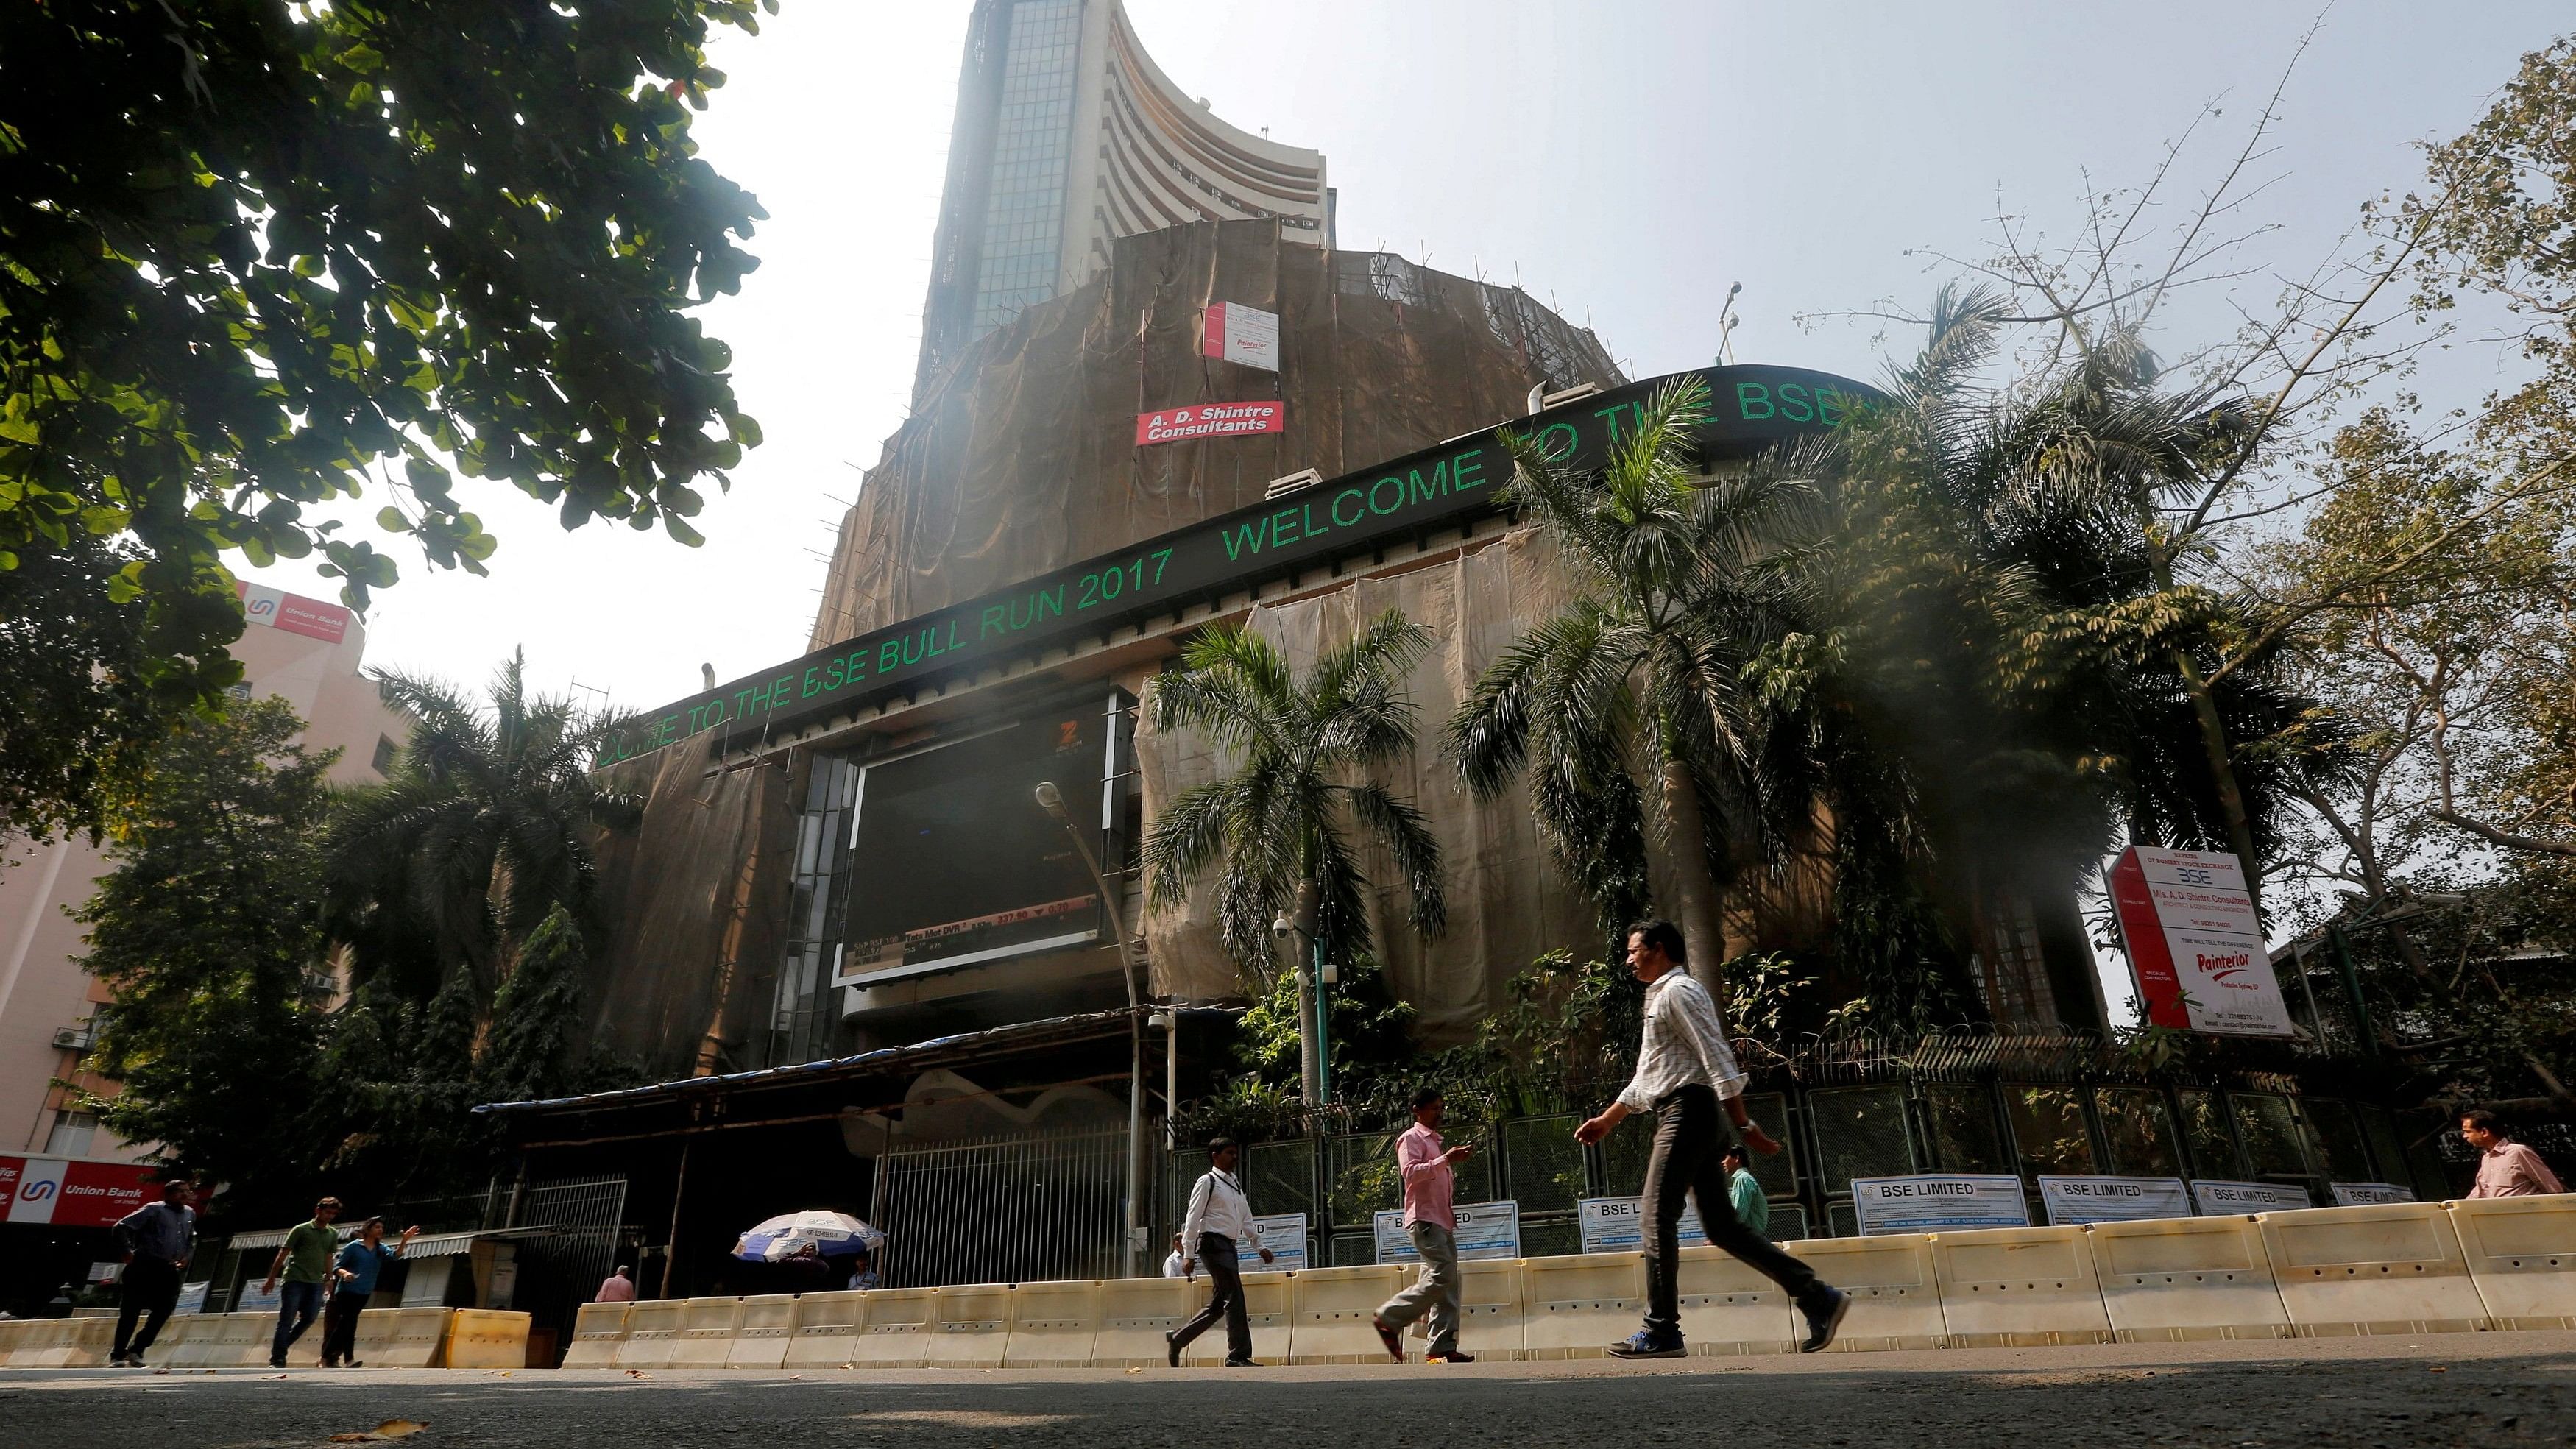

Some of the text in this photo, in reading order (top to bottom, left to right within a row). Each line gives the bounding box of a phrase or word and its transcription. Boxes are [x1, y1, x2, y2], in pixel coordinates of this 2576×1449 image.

[1236, 339, 1267, 349] Painterior
[1148, 406, 1273, 428] A. D. Shintre
[1148, 419, 1267, 440] Consultants
[688, 699, 725, 735] TO
[735, 675, 793, 720] THE
[877, 620, 967, 674] BULL
[980, 584, 1066, 640] RUN
[1077, 548, 1173, 610] 2017
[1222, 449, 1486, 561] WELCOME
[1736, 382, 1844, 427] BSE
[286, 606, 344, 626] Union Bank
[2156, 858, 2181, 866] BOMBAY
[2201, 862, 2234, 871] EXCHANGE
[2176, 868, 2213, 885] BSE
[2170, 891, 2177, 899] A.
[2178, 891, 2186, 900] D.
[2187, 892, 2211, 902] Shintre
[2212, 894, 2251, 907] Consultants
[942, 924, 960, 935] DVR
[2227, 941, 2254, 949] DIFFERENCE
[2196, 951, 2249, 973] Painterior
[66, 1184, 144, 1198] Union Bank
[1881, 1185, 1914, 1197] BSE
[1917, 1183, 1975, 1196] LIMITED
[2063, 1184, 2091, 1196] BSE
[2094, 1184, 2141, 1197] LIMITED
[2213, 1188, 2276, 1203] BSE LIMITED
[2349, 1191, 2371, 1202] BSE
[1601, 1203, 1629, 1216] BSE
[806, 1218, 837, 1226] BSE
